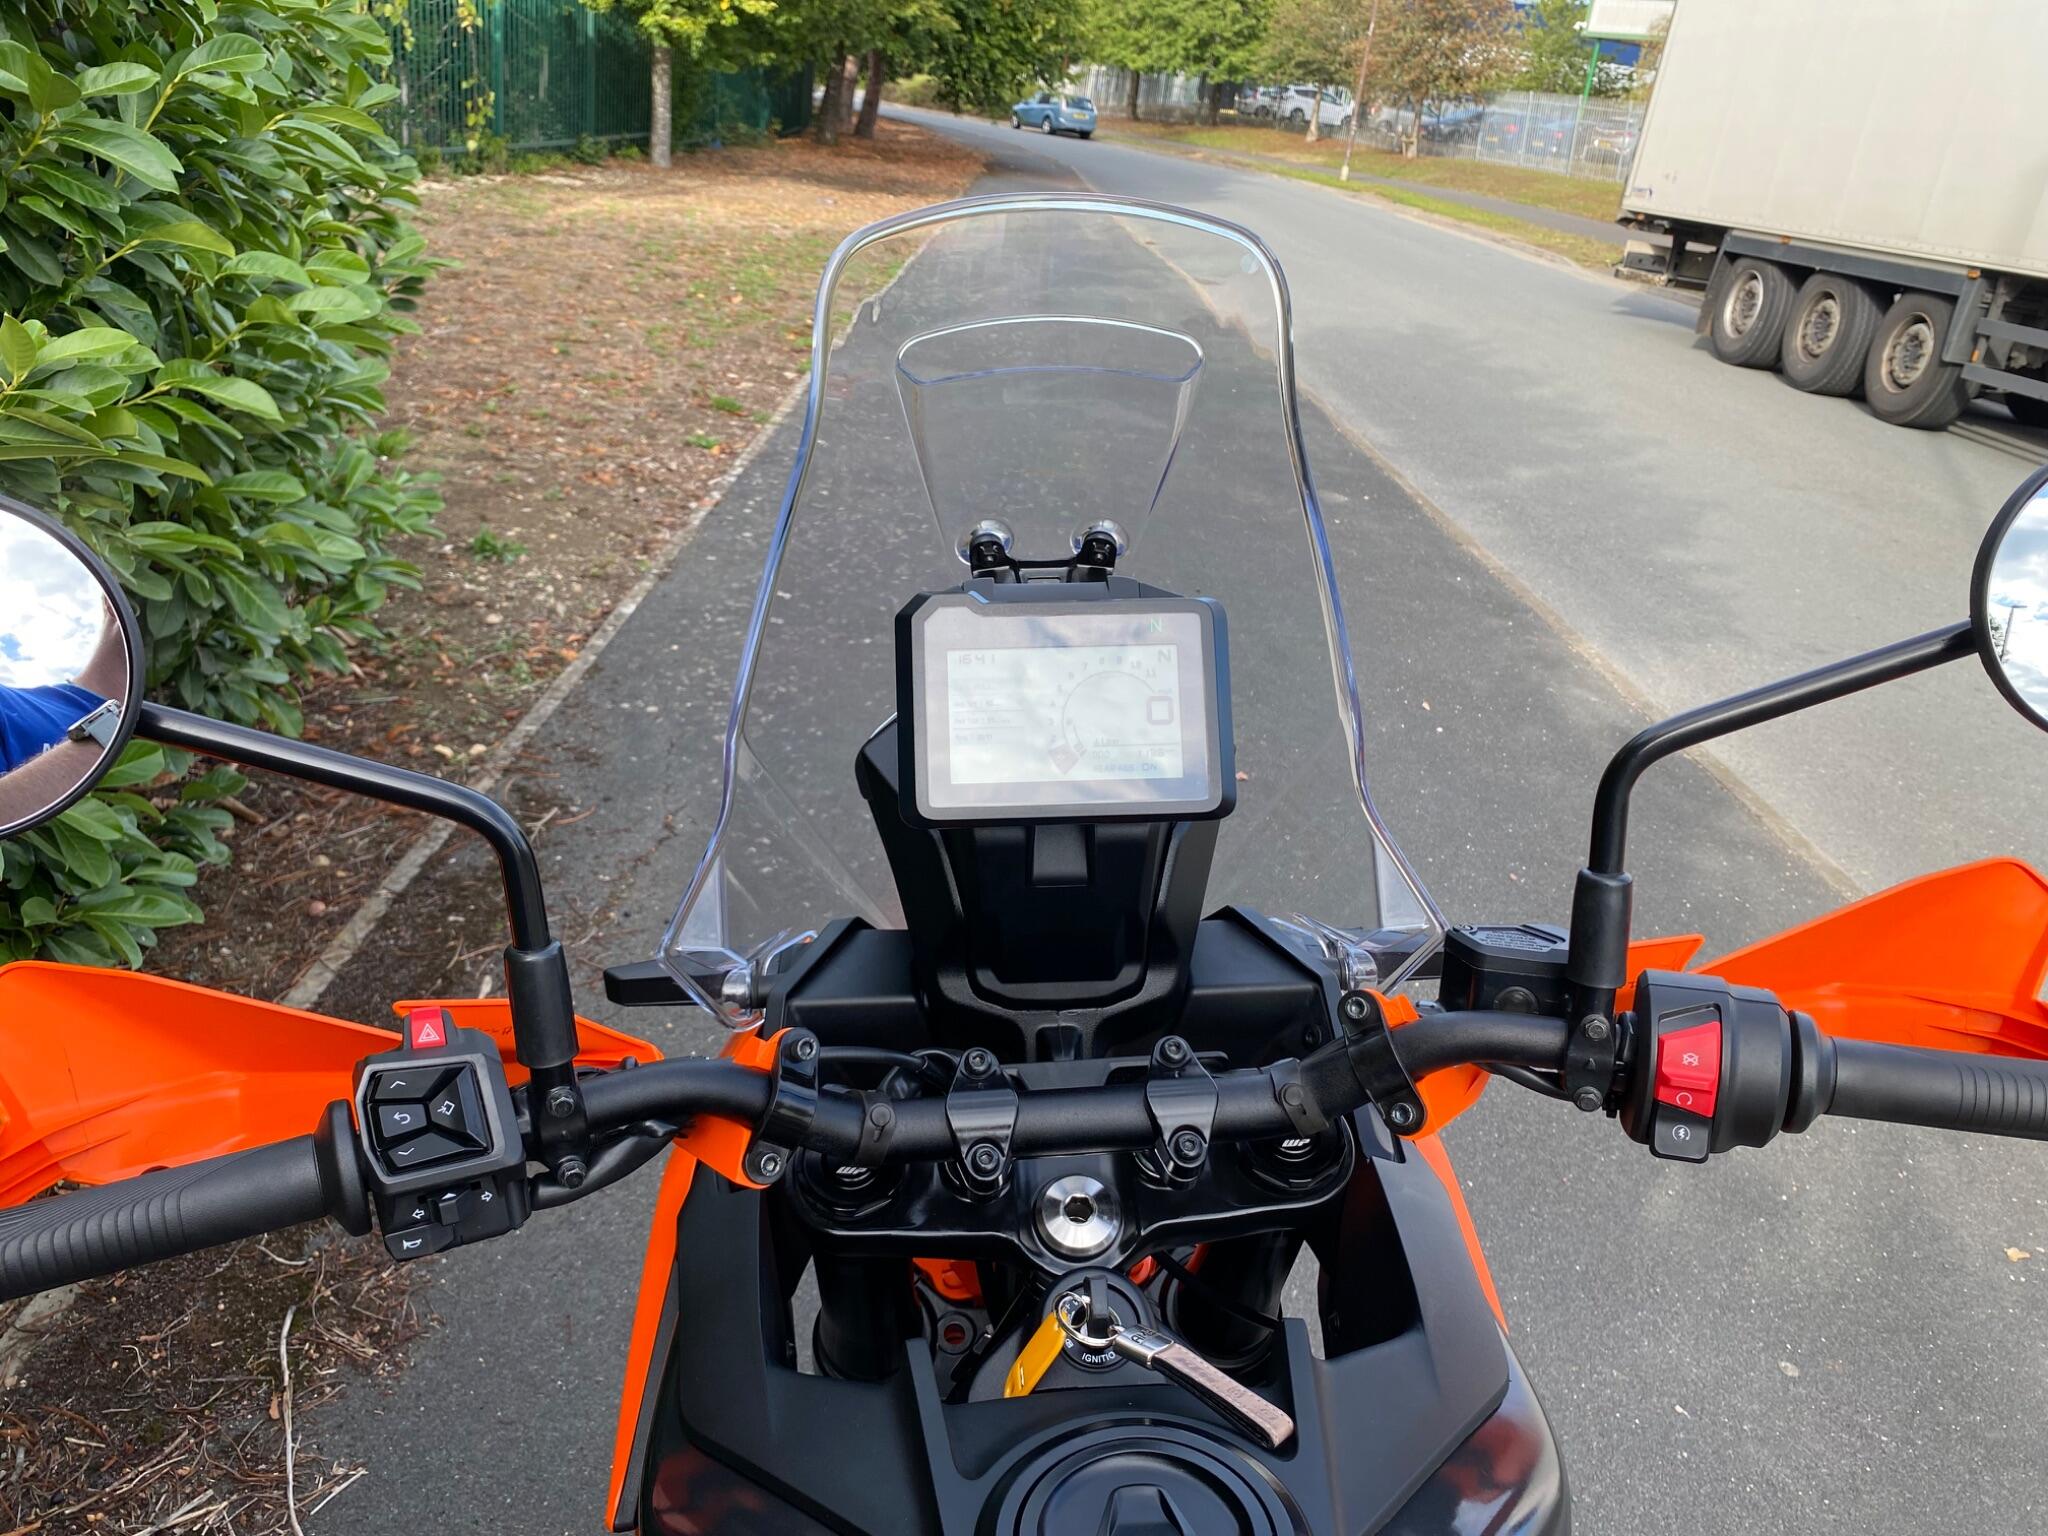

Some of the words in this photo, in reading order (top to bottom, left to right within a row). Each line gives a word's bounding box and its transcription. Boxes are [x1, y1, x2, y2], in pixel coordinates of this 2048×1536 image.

[1150, 616, 1162, 633] N
[1158, 648, 1172, 663] N
[1282, 1138, 1311, 1148] WP
[836, 1166, 868, 1175] WP
[1081, 1350, 1116, 1364] IGNITIO
